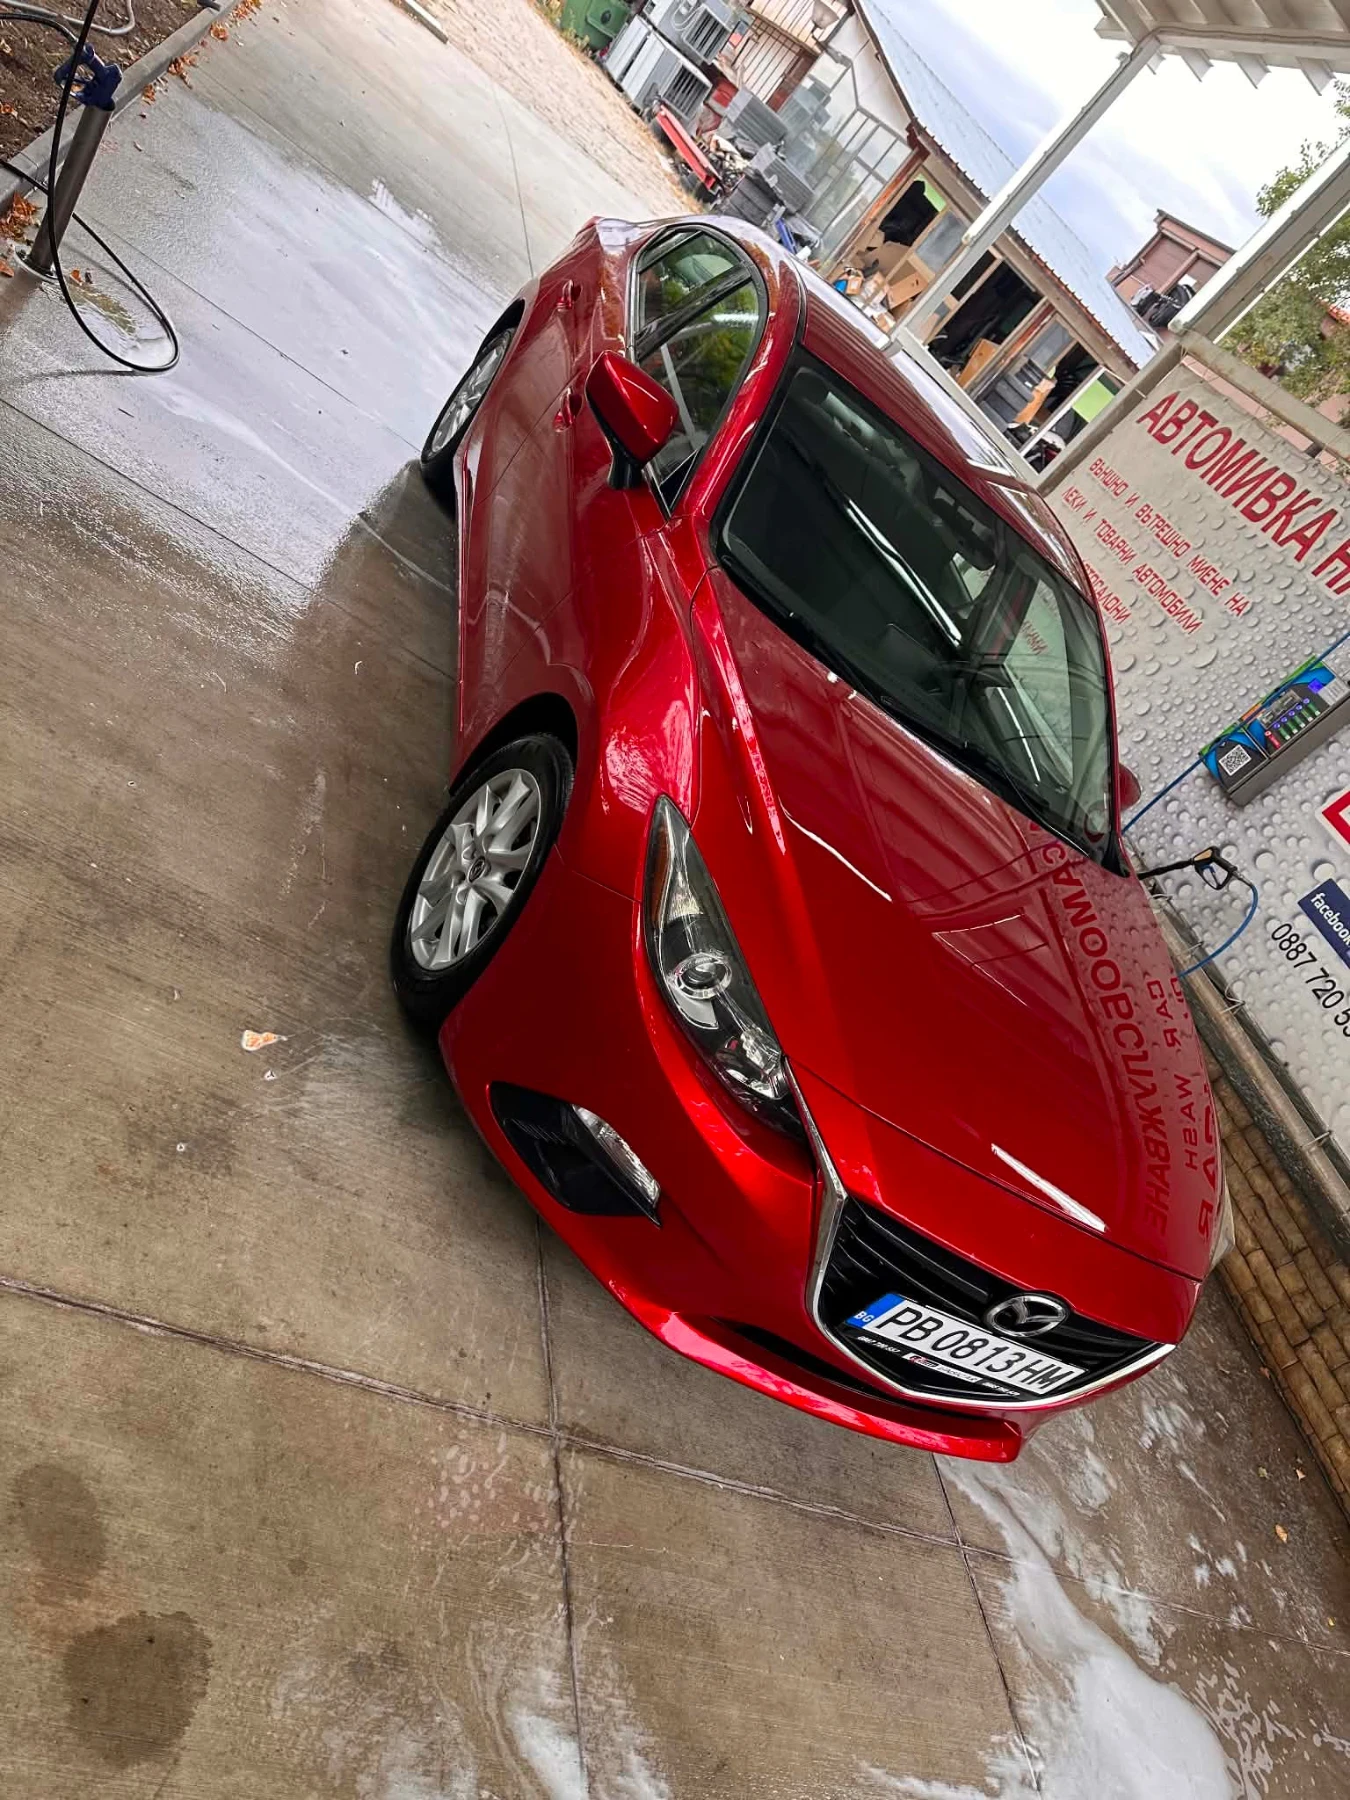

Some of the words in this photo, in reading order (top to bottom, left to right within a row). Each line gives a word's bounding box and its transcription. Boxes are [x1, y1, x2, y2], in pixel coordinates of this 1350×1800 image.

[1136, 391, 1338, 562] АВТОМИВКА
[1061, 485, 1087, 512] ЛЕКИ
[1083, 508, 1097, 522] И
[1094, 518, 1137, 565] ТОВАРНИ
[1132, 563, 1202, 634] АВТОМОБИЛИ
[1125, 492, 1140, 508] И
[1186, 554, 1230, 596] МИЕНЕ
[1224, 592, 1250, 617] НА
[1271, 923, 1317, 968] 0887
[1305, 967, 1344, 1009] 720
[853, 1310, 874, 1323] BG
[931, 1329, 1026, 1373] 0813
